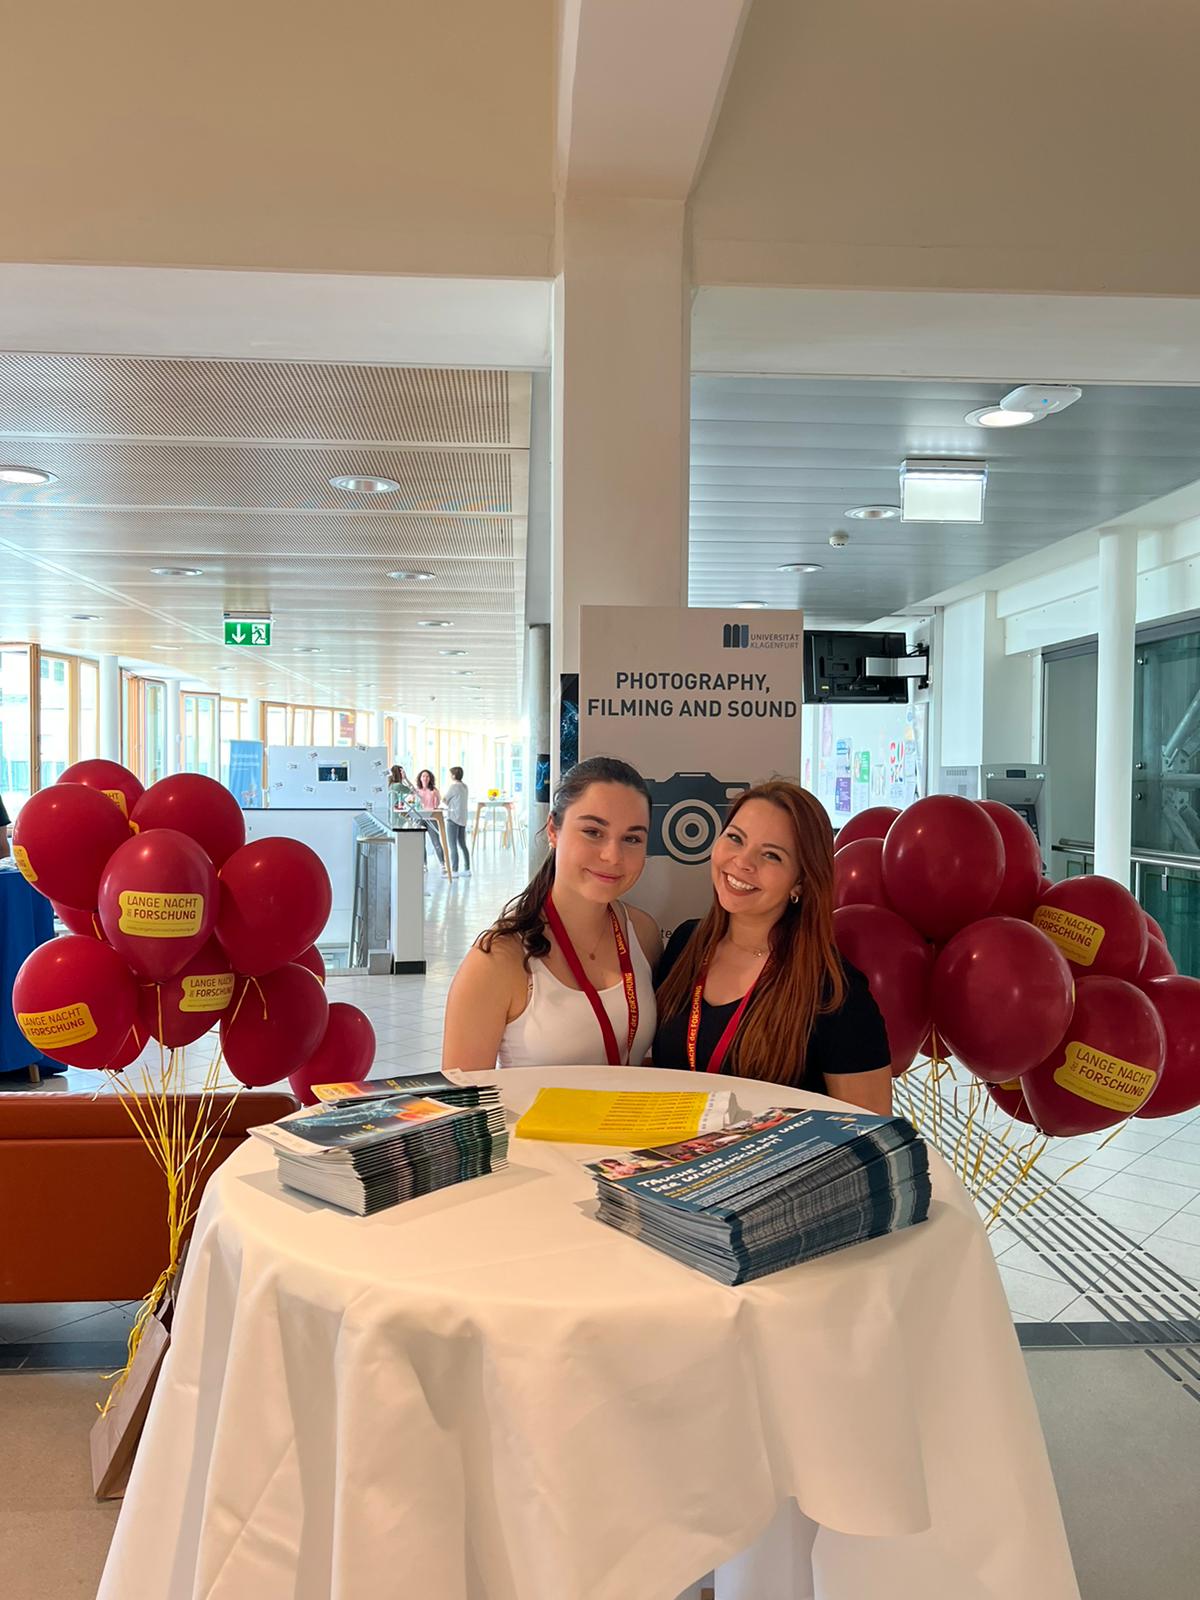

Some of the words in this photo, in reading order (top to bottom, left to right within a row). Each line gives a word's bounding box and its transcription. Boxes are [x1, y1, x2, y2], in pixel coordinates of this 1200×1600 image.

[750, 631, 800, 641] UNIVERSITÄT
[750, 641, 799, 649] KLAGENFURT
[616, 672, 770, 694] PHOTOGRAPHY,
[587, 698, 673, 717] FILMING
[679, 700, 722, 718] AND
[727, 700, 797, 719] SOUND
[127, 895, 160, 908] LANGE
[163, 898, 198, 909] NACHT
[133, 908, 196, 921] FORSCHUNG
[1038, 919, 1092, 948] FORSCHUNG
[1064, 916, 1098, 936] NACHT
[190, 978, 216, 988] LANGE
[48, 1007, 81, 1024] NACHT
[691, 985, 702, 1028] FORSCHUNG
[30, 1017, 86, 1037] FORSCHUNG
[1076, 1049, 1116, 1074] LANGE
[1117, 1066, 1152, 1085] NACHT
[1078, 1065, 1145, 1097] FORSCHUNG
